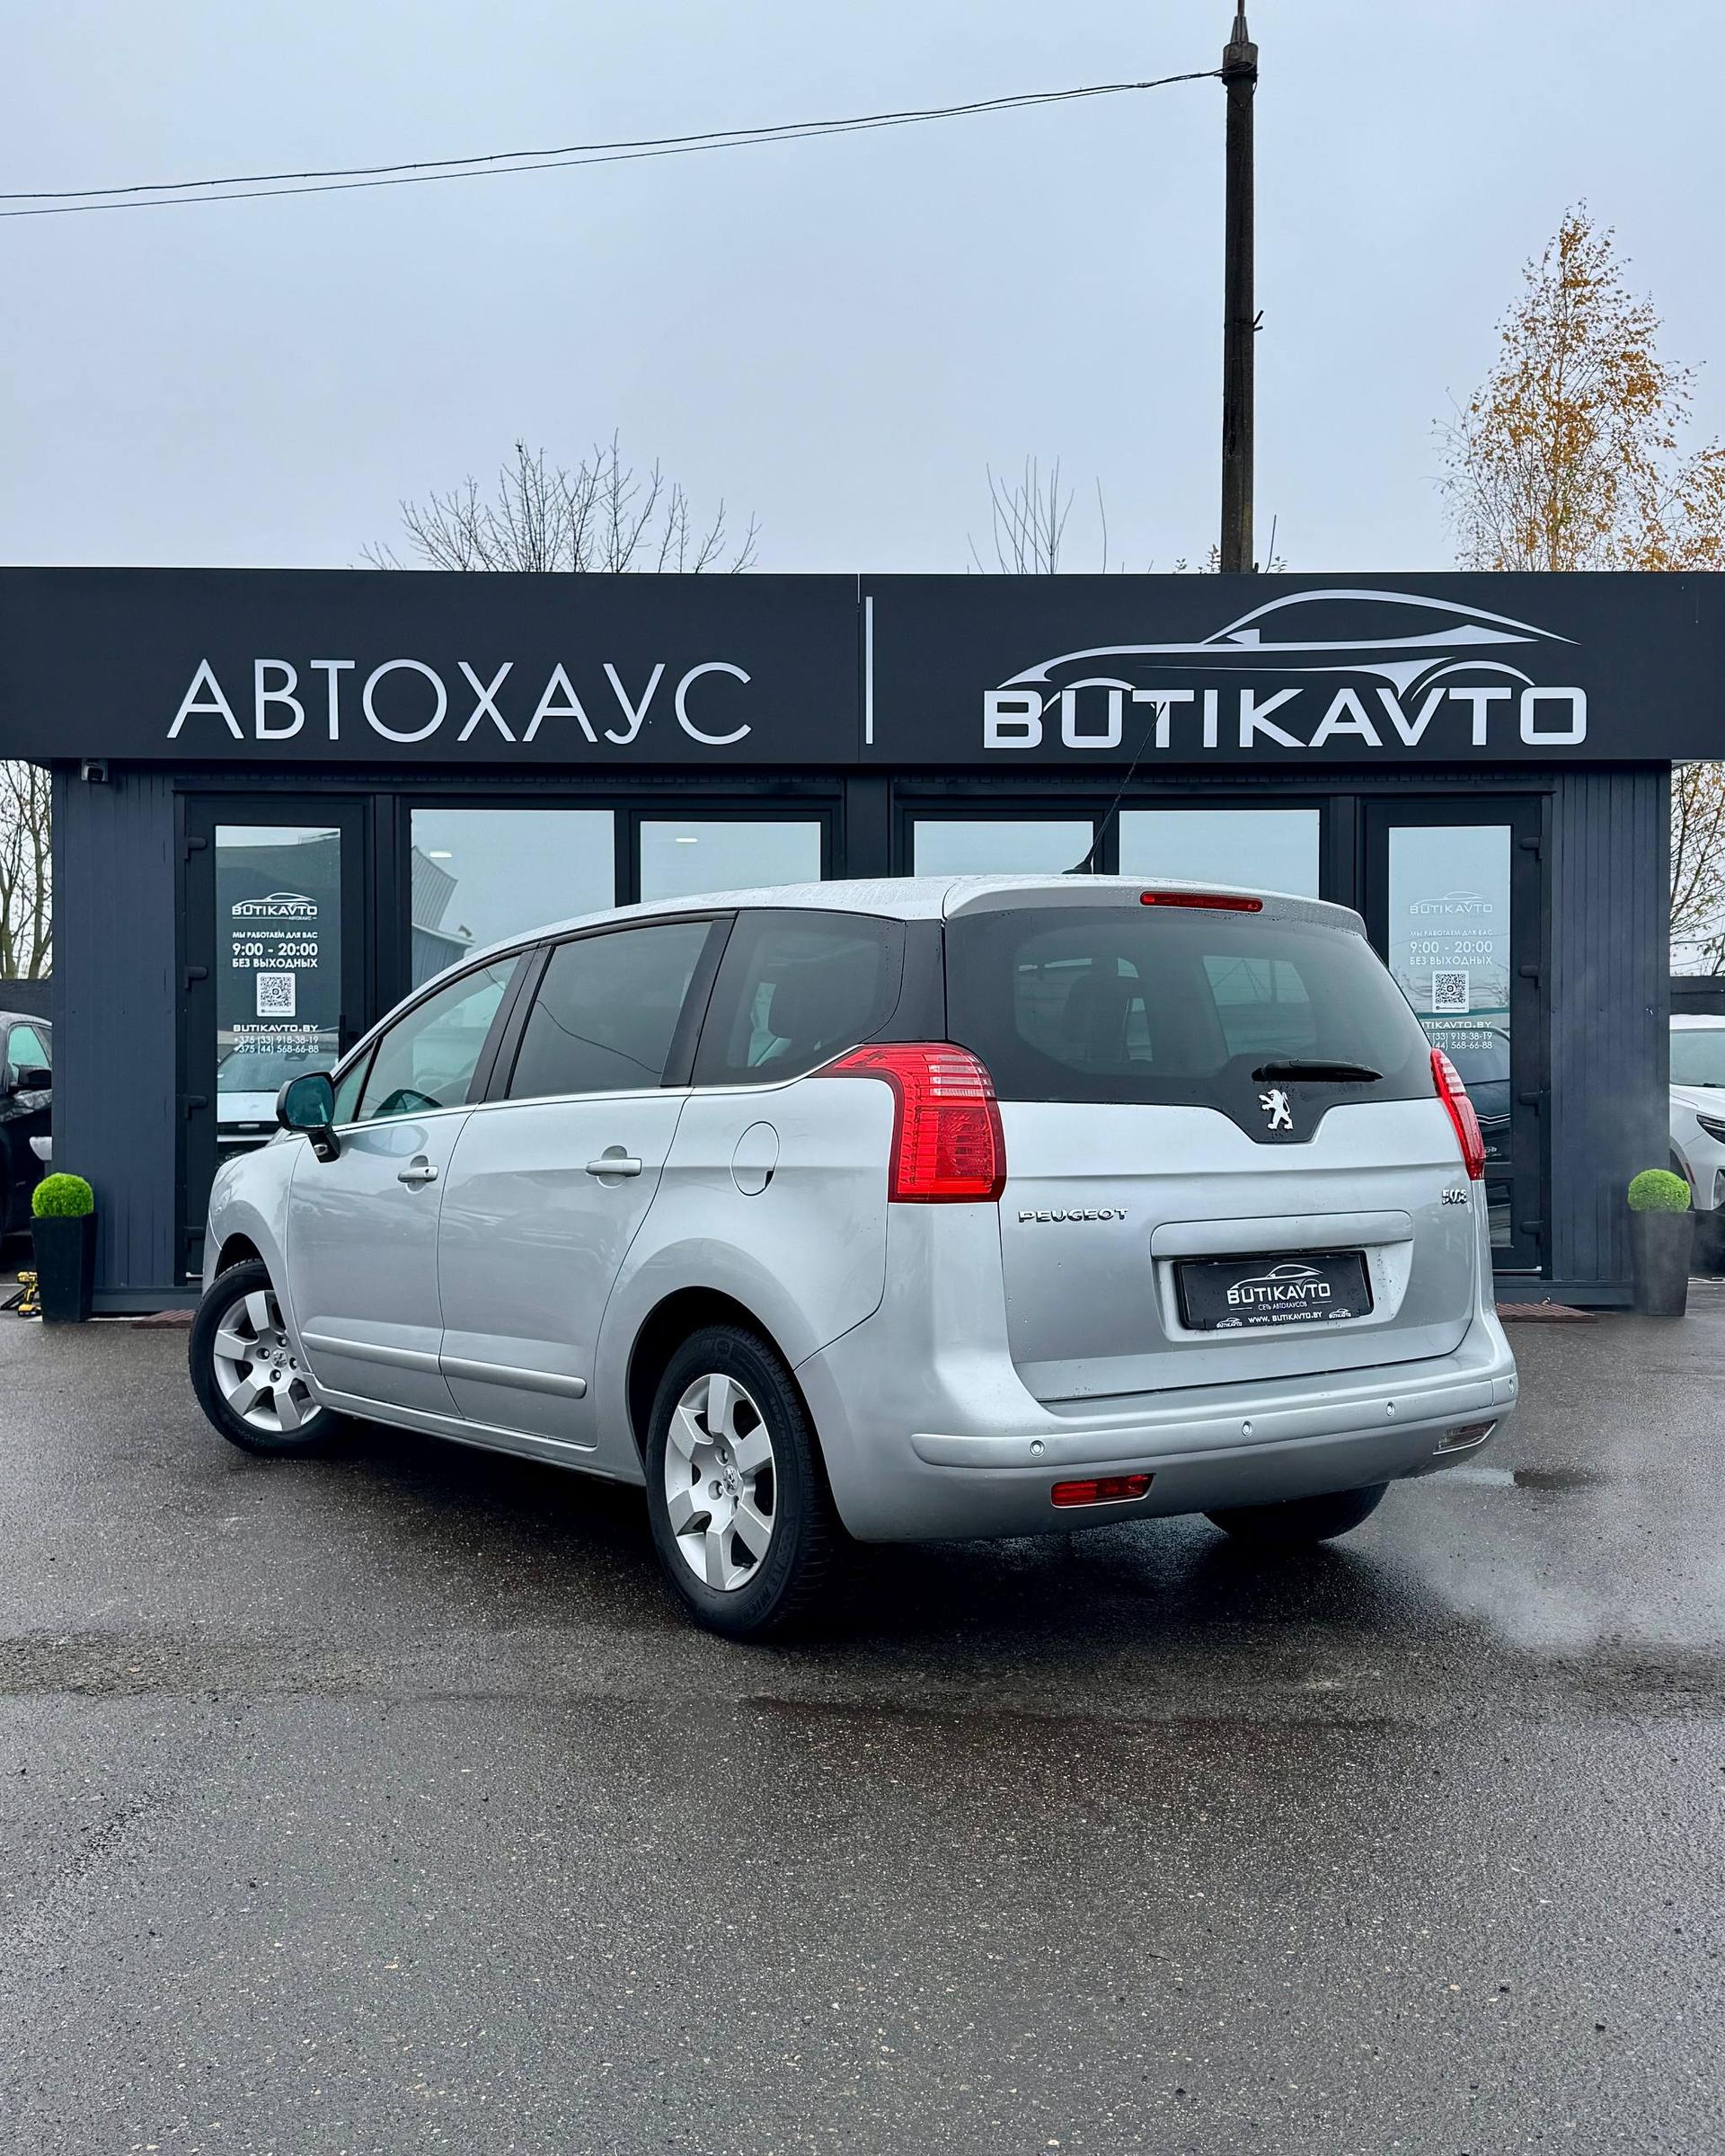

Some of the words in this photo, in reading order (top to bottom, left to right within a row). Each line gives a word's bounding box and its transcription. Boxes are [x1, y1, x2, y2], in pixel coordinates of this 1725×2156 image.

[167, 658, 753, 745] АВТОХАУС
[984, 686, 1588, 748] BUTIKAVTO
[232, 906, 317, 915] BUTIKAVTO
[1410, 904, 1492, 914] BUTIKAVTO
[232, 942, 263, 956] 9:00
[278, 942, 318, 956] 20:00
[1410, 941, 1439, 953] 9:00
[1455, 941, 1492, 953] 20:00
[232, 958, 251, 968] БЕЗ
[253, 958, 318, 968] ВЫХОДНЫХ
[1410, 956, 1427, 965] БЕЗ
[1429, 956, 1492, 965] ВЫХОДНЫХ
[233, 1024, 319, 1032] BUTIKAVTO.BY
[257, 1035, 274, 1045] (33)
[276, 1036, 319, 1044] 918-38-19
[1432, 1032, 1448, 1041] (33)
[1451, 1031, 1492, 1040] 918-38-19
[257, 1044, 274, 1054] (44)
[277, 1044, 319, 1053] 568-66-88
[1451, 1041, 1492, 1049] 568-66-88
[1018, 1207, 1128, 1223] PEUGEOT
[1226, 1283, 1331, 1304] BUTIKAVTO
[1271, 1312, 1322, 1322] BUTIKAVTO.BY
